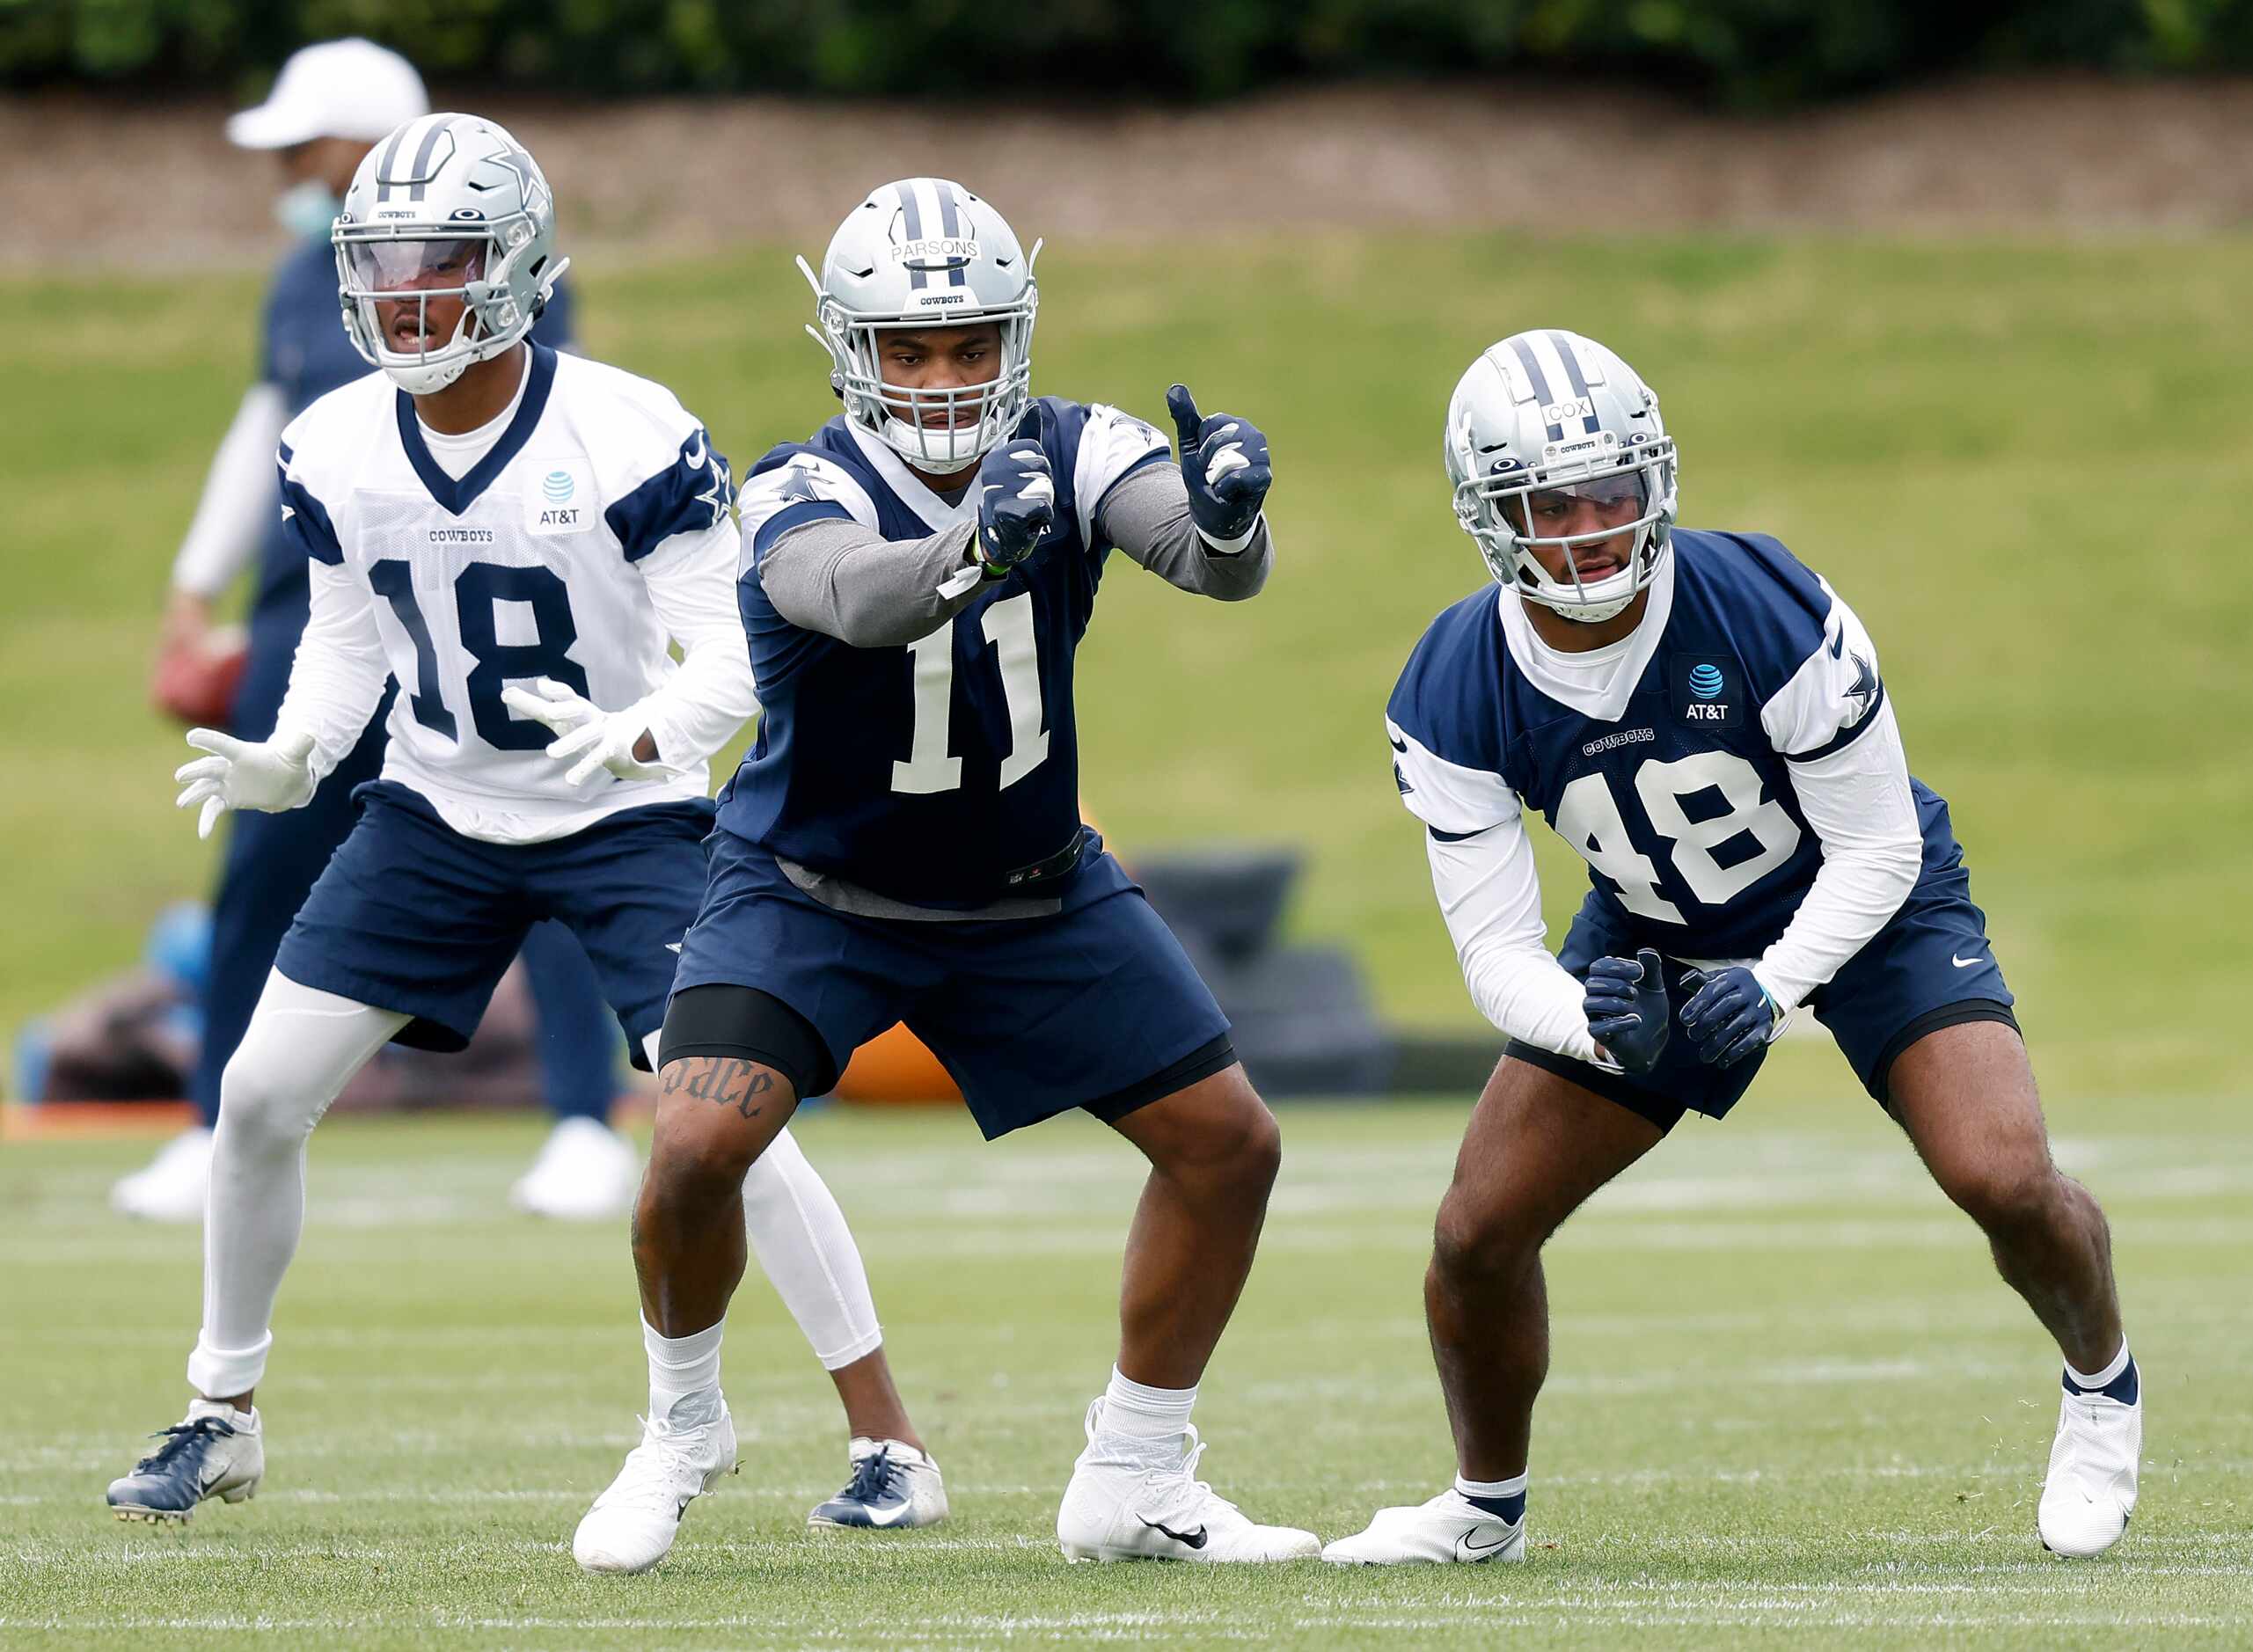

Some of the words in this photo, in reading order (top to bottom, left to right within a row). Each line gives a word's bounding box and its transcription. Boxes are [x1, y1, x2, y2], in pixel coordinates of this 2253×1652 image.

[891, 240, 978, 261] PARSONS
[920, 295, 964, 305] COWBOYS
[1549, 400, 1589, 420] COX
[1561, 441, 1596, 454] COWBOYS
[539, 509, 579, 525] AT&T
[429, 530, 493, 542] COWBOYS
[368, 559, 592, 751] 18
[890, 591, 1050, 793] 11
[1686, 705, 1728, 720] AT&T
[1583, 728, 1655, 756] COWBOYS
[1554, 750, 1802, 925] 48
